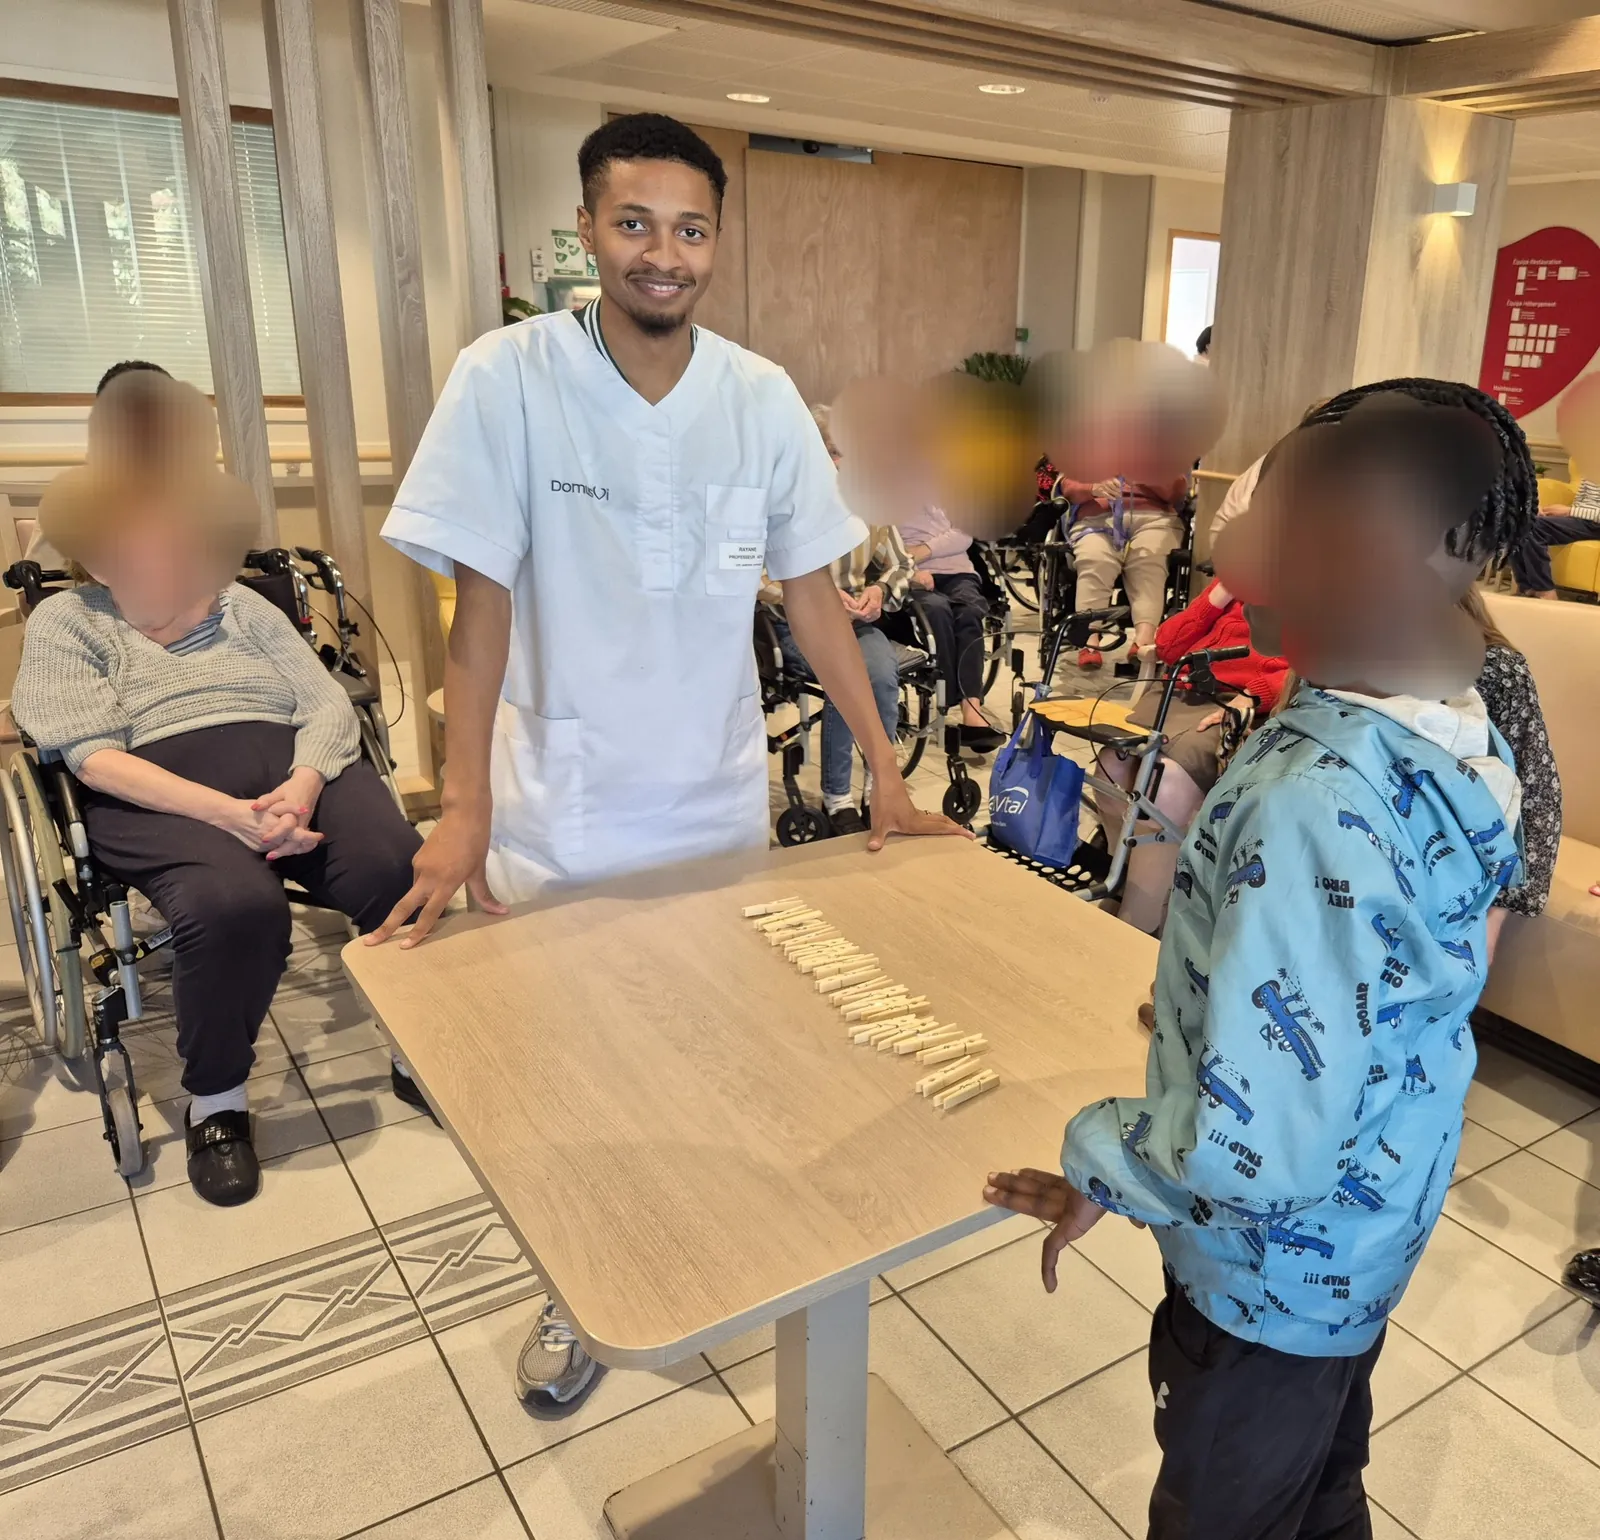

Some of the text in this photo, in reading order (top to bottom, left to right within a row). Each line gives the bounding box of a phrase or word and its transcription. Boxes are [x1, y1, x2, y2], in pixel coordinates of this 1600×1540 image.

[1322, 877, 1350, 893] BRO
[1327, 895, 1355, 909] HEY
[1383, 955, 1411, 977] SNA
[1380, 969, 1404, 989] OH
[1355, 982, 1370, 1037] ROOAAR
[1228, 1140, 1264, 1168] SNAP
[1233, 1159, 1257, 1180] OH
[1322, 1275, 1350, 1287] SNAP
[1331, 1288, 1350, 1300] OH
